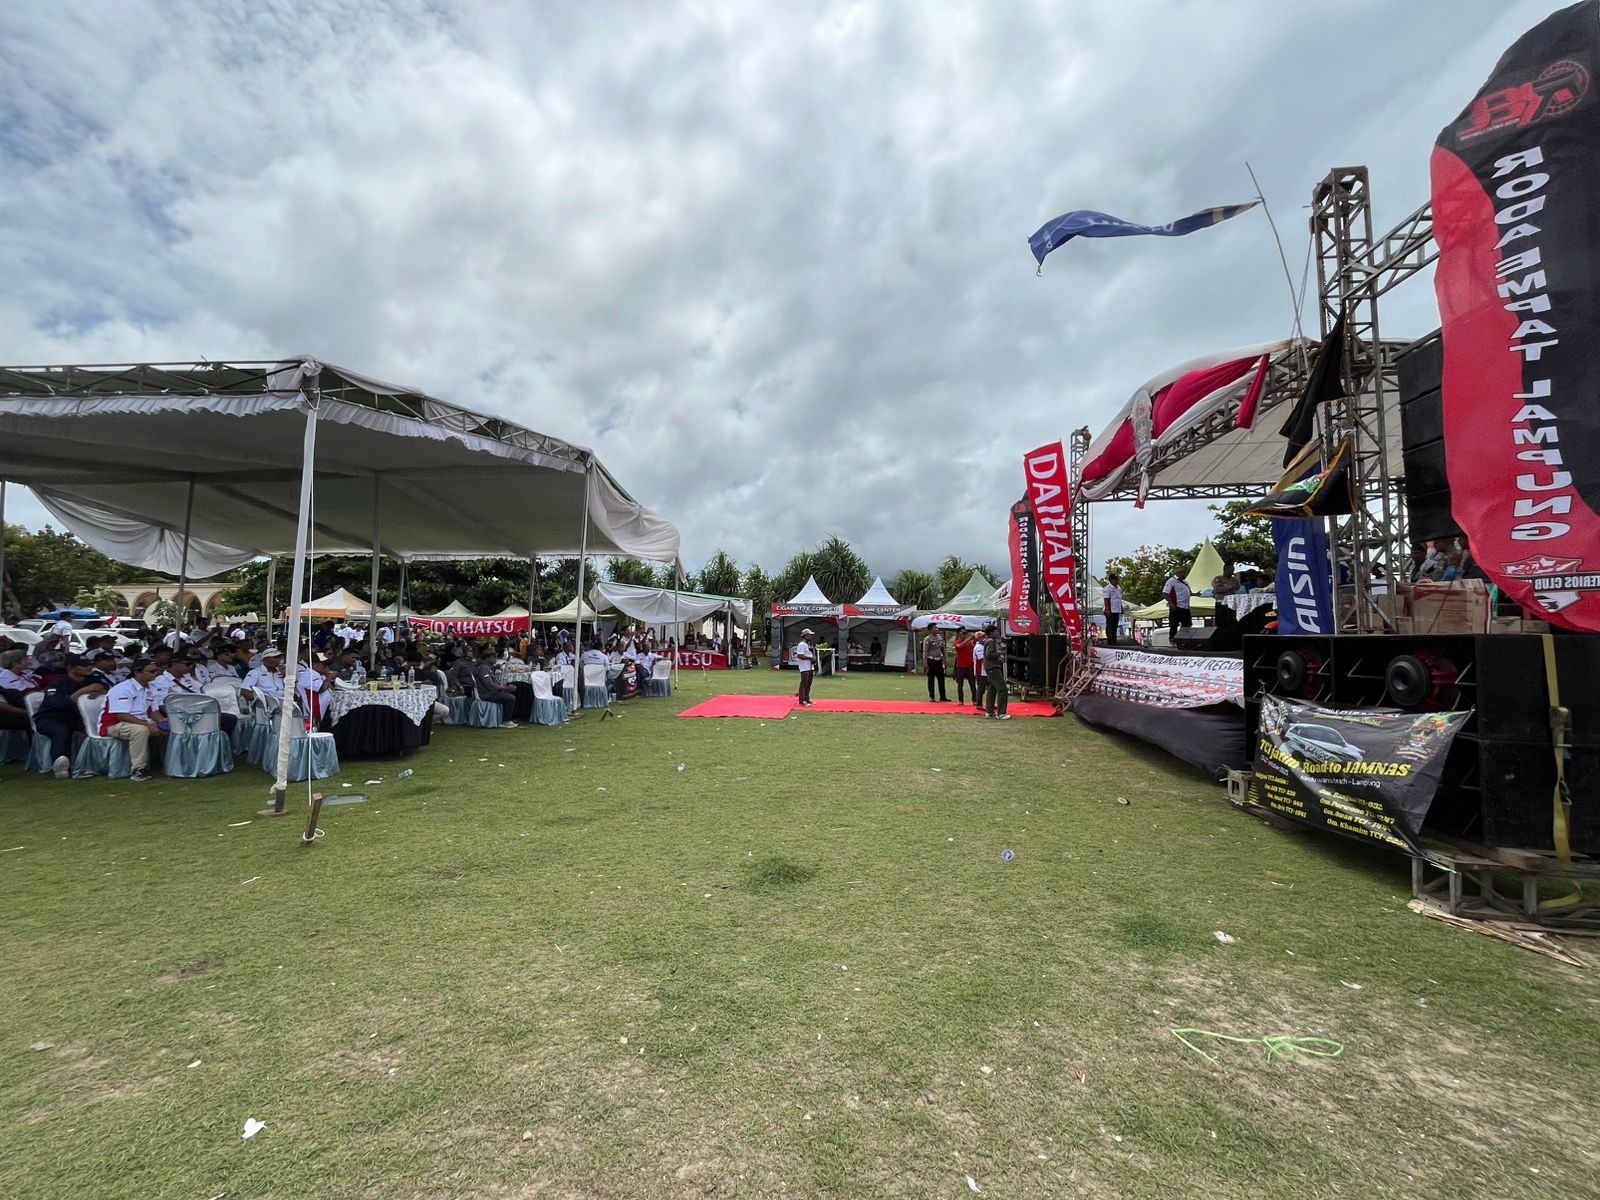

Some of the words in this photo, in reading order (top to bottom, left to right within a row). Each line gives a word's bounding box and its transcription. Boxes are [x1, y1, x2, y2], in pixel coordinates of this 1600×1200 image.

[1028, 453, 1079, 640] DAIHAT
[1287, 536, 1321, 634] AISIN
[434, 620, 516, 634] DAIHATSU
[1260, 739, 1273, 753] TCI
[1342, 761, 1411, 776] JAMNAS
